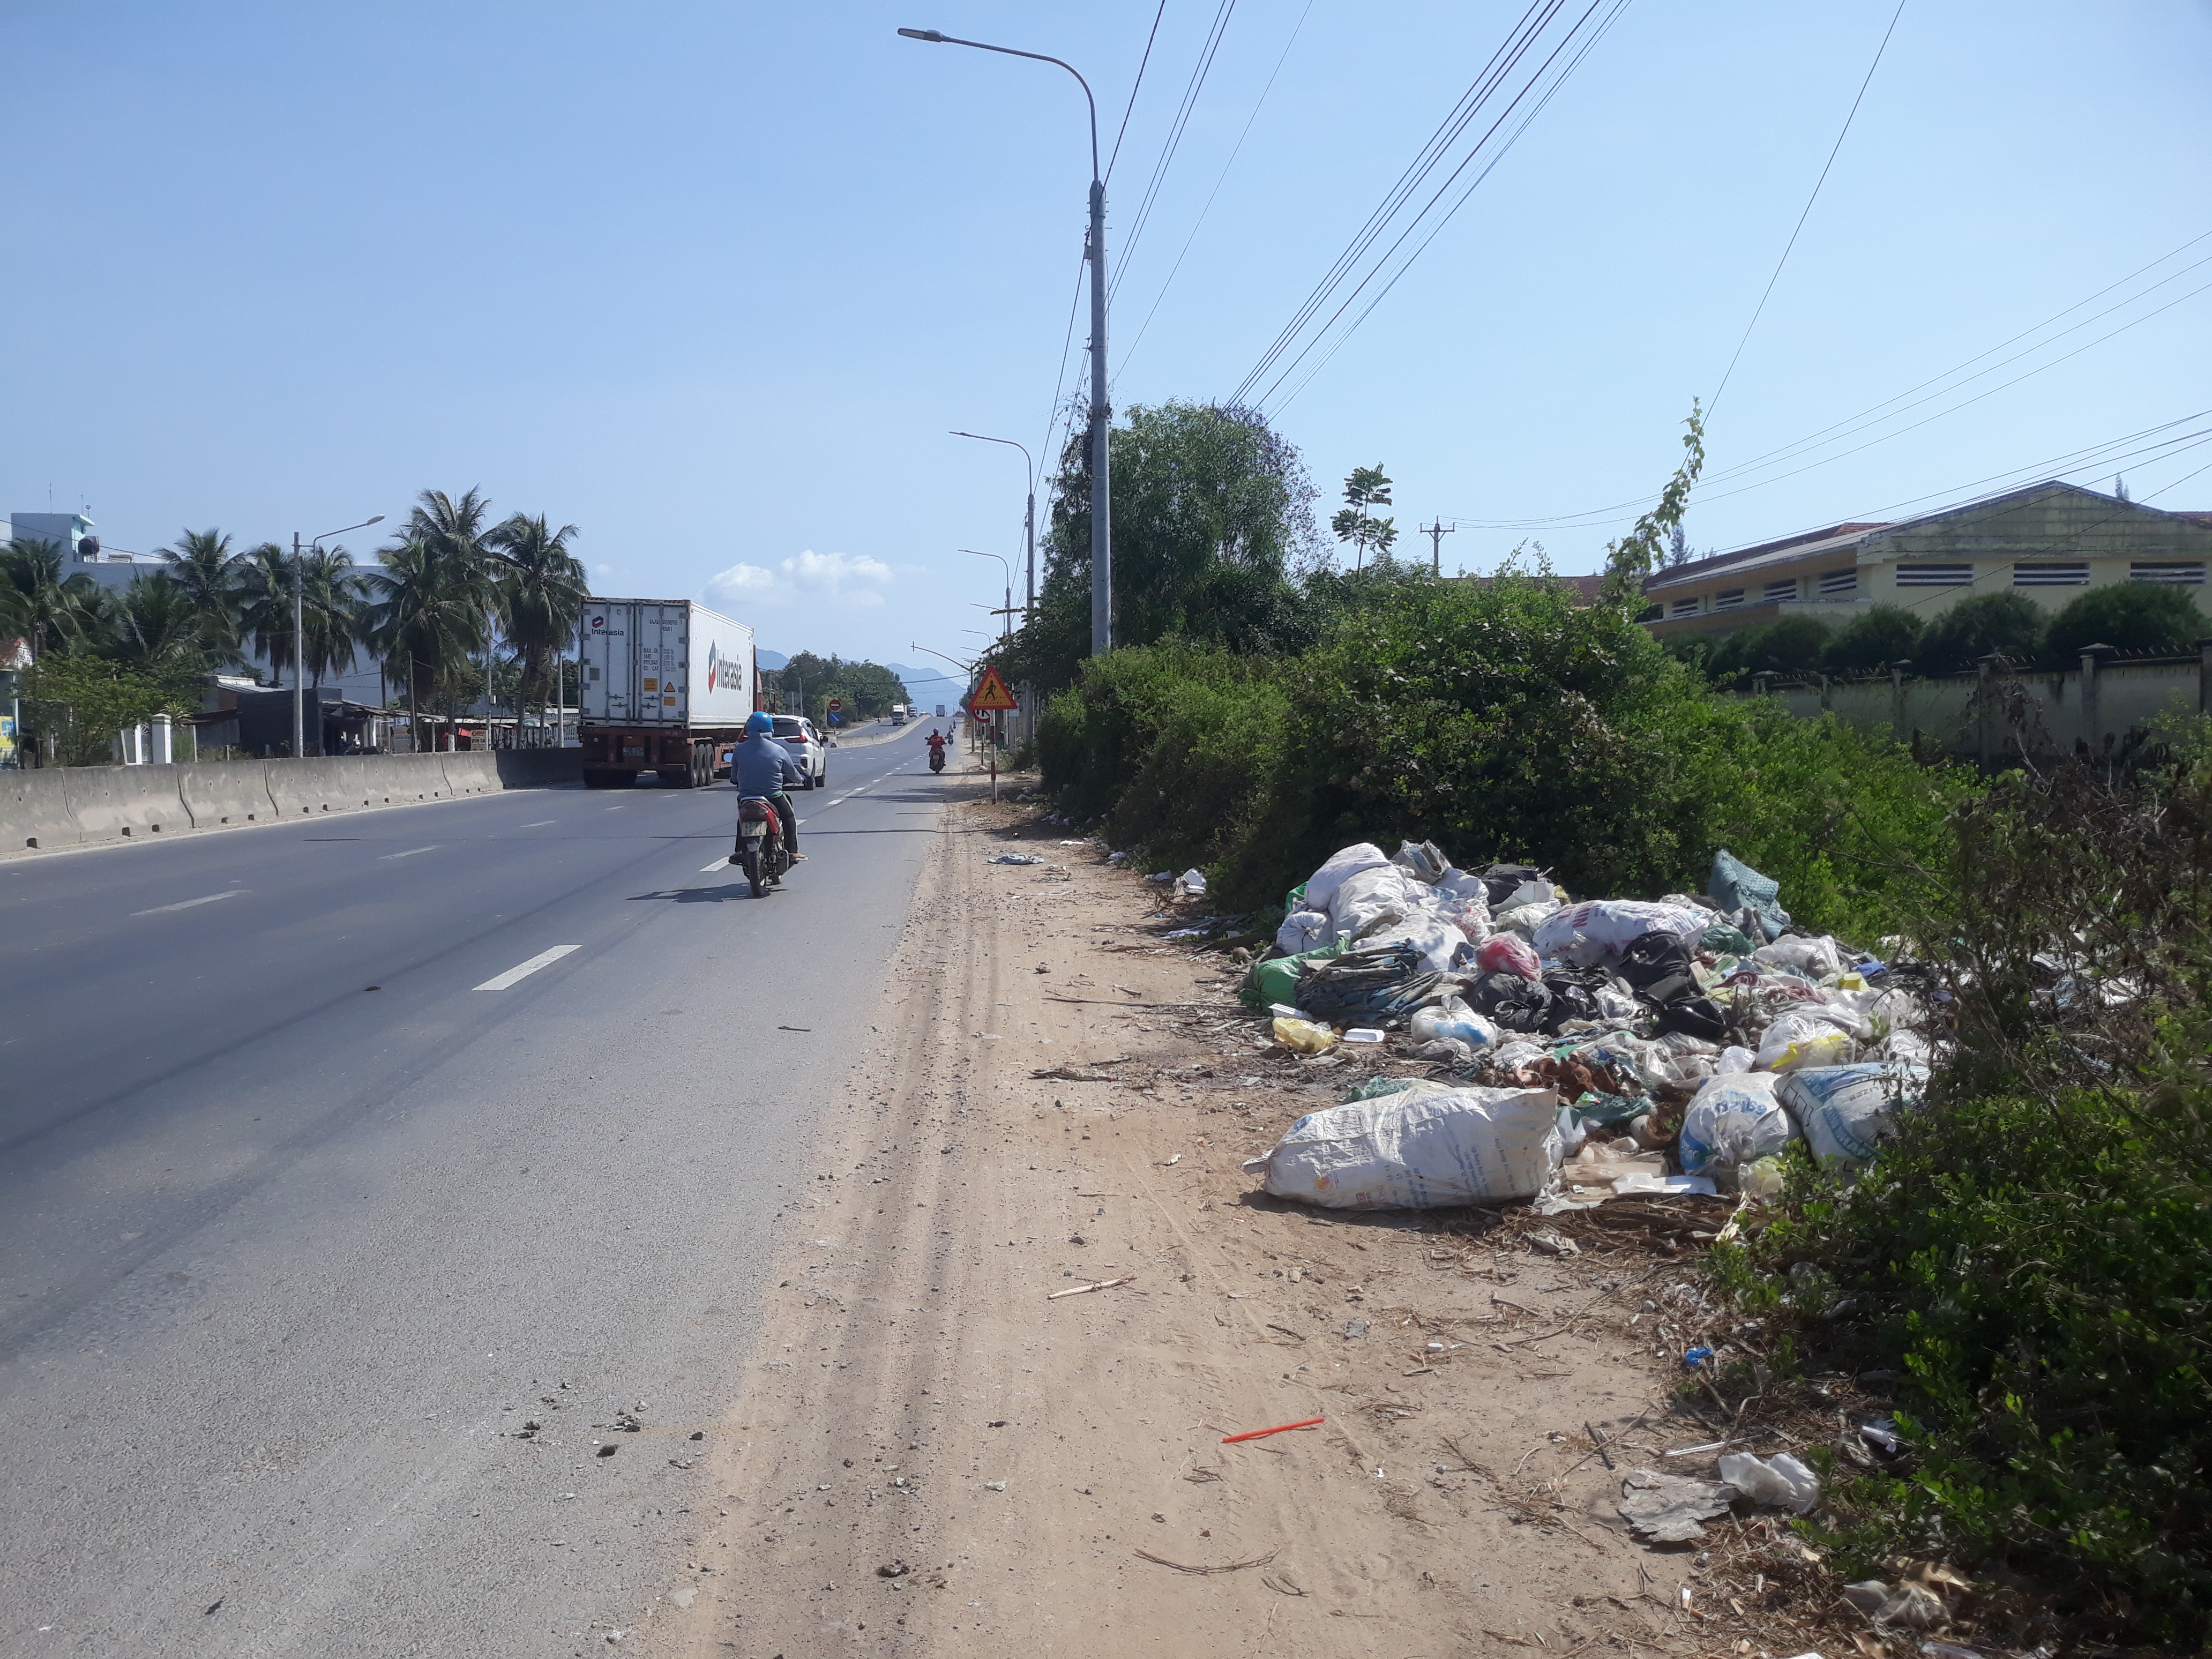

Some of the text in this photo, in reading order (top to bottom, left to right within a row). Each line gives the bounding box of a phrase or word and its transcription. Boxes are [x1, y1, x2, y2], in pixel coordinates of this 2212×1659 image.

[592, 628, 624, 636] Interasia
[716, 648, 742, 691] Interasia
[1449, 917, 1476, 938] Mart
